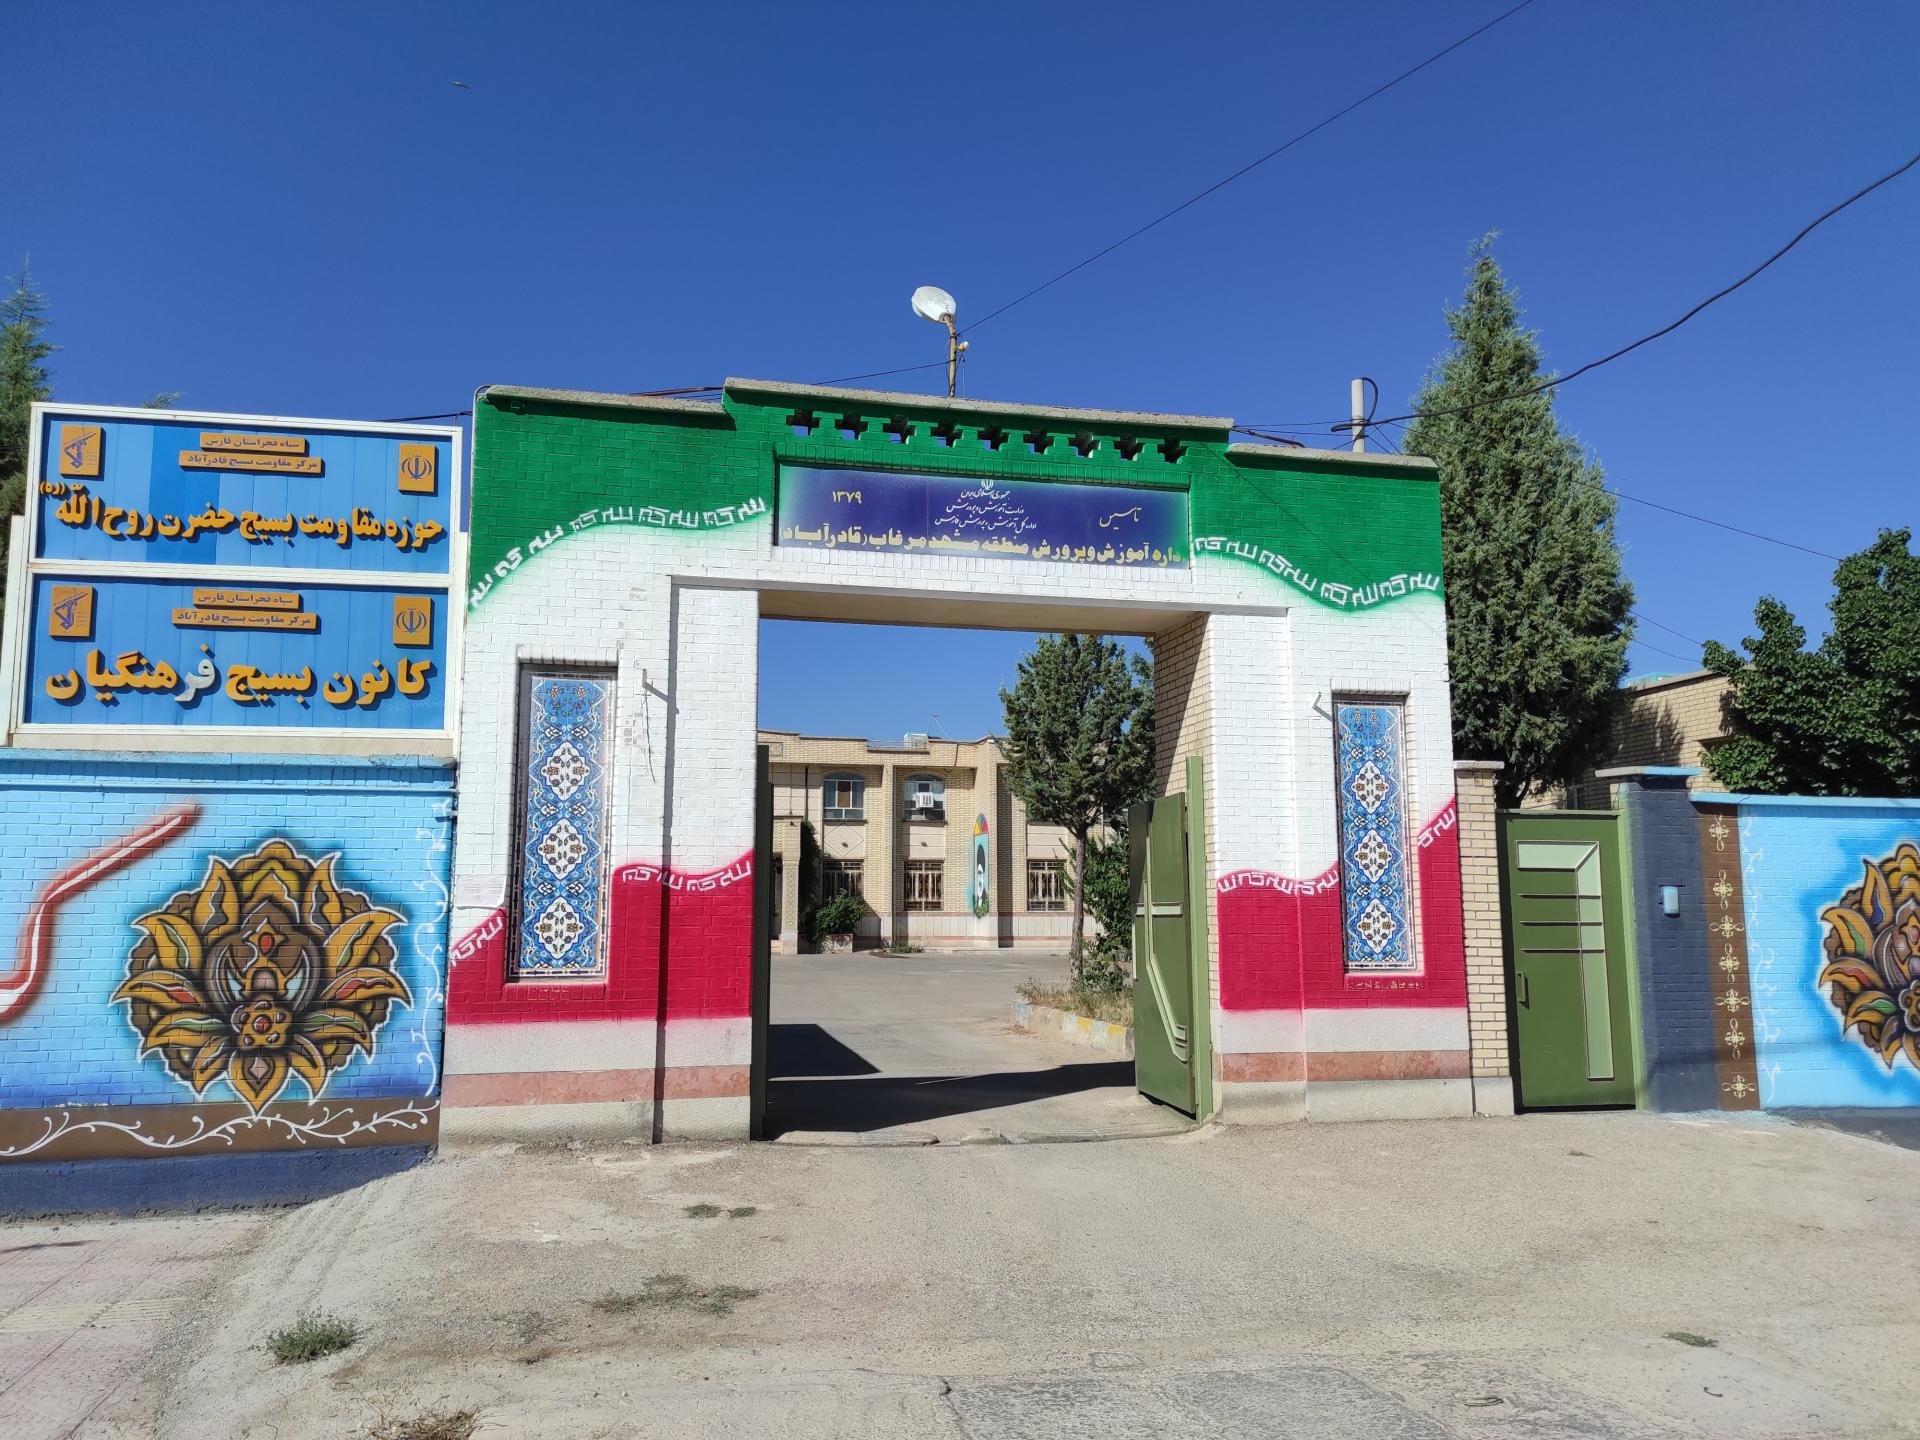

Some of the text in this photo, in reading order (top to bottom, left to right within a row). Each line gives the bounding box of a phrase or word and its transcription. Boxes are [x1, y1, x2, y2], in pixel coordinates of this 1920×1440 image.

[206, 436, 232, 447] فارس
[256, 457, 292, 468] مقاومت
[295, 459, 319, 470] مرکز
[832, 490, 863, 505] ۱۳۷۹
[960, 489, 975, 500] ایران
[991, 490, 1010, 501] جمهوری
[978, 500, 1007, 514] آموزش
[1004, 505, 1025, 514] وزارت
[103, 506, 154, 537] روح
[157, 502, 236, 538] حضرت
[240, 510, 293, 543] بسیج
[299, 506, 381, 545] مقاومت
[934, 514, 959, 526] فارس
[987, 515, 1019, 530] آموزش
[1014, 516, 1029, 534] کل
[1025, 522, 1037, 530] اداره
[385, 515, 443, 548] حوزه
[868, 527, 927, 551] مرغاب
[928, 528, 980, 551] مشهد
[981, 535, 1029, 556] منطقه
[1097, 542, 1150, 563] آموزش
[198, 592, 225, 602] فارس
[221, 614, 246, 624] بسیج
[248, 615, 285, 625] مقاومت
[287, 615, 312, 626] مرکز
[45, 643, 430, 704] کانون بسیج فرهنگیان
